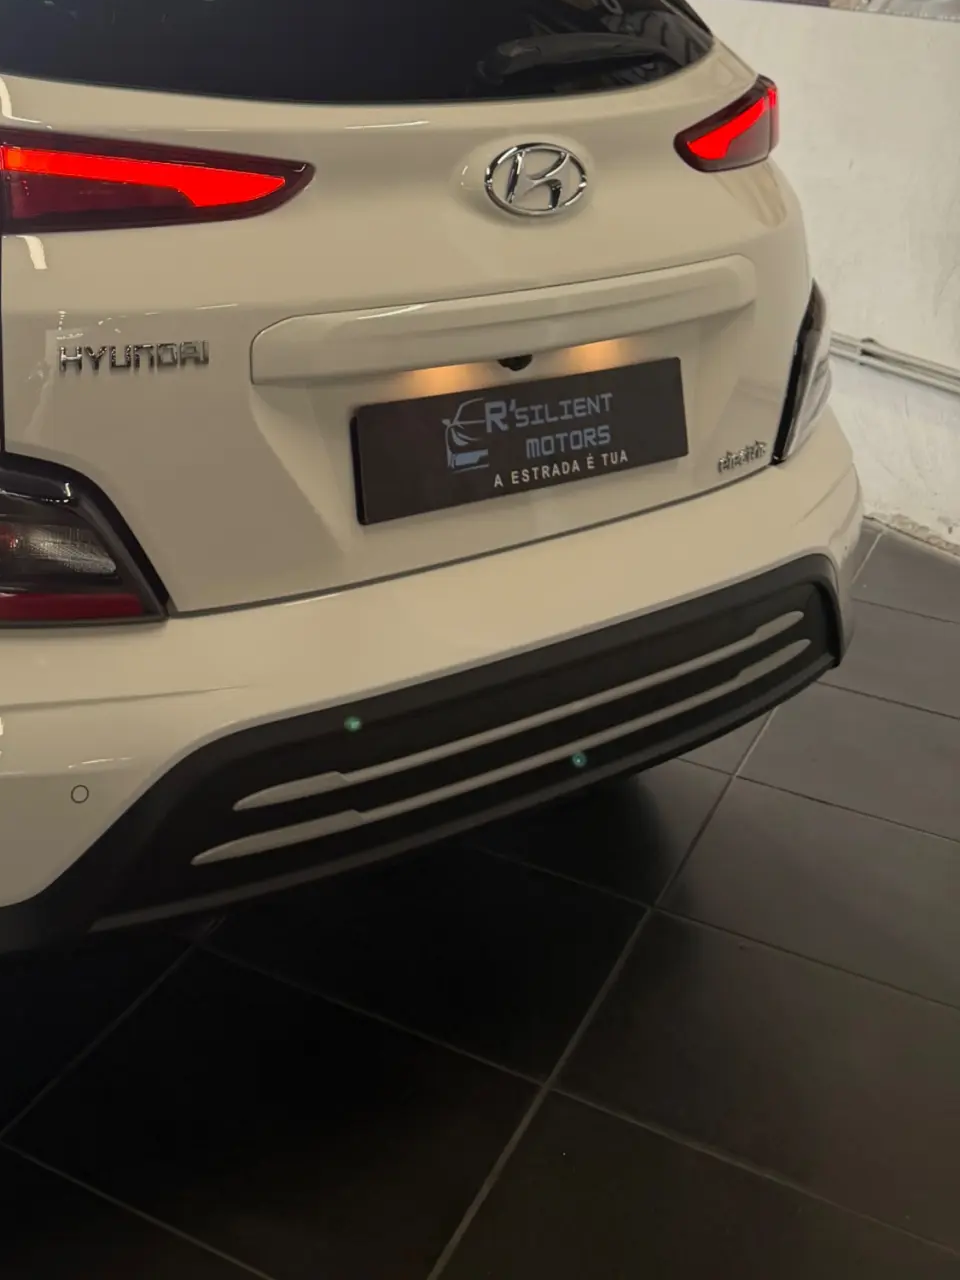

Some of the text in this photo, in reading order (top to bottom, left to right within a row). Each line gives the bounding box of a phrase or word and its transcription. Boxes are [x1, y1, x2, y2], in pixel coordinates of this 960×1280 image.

[59, 340, 209, 372] HYUNDAI
[484, 392, 613, 433] R'SILIENT
[526, 425, 612, 459] MOTORS
[493, 474, 504, 488] A
[511, 460, 581, 485] ESTRADA
[602, 449, 629, 467] TUA
